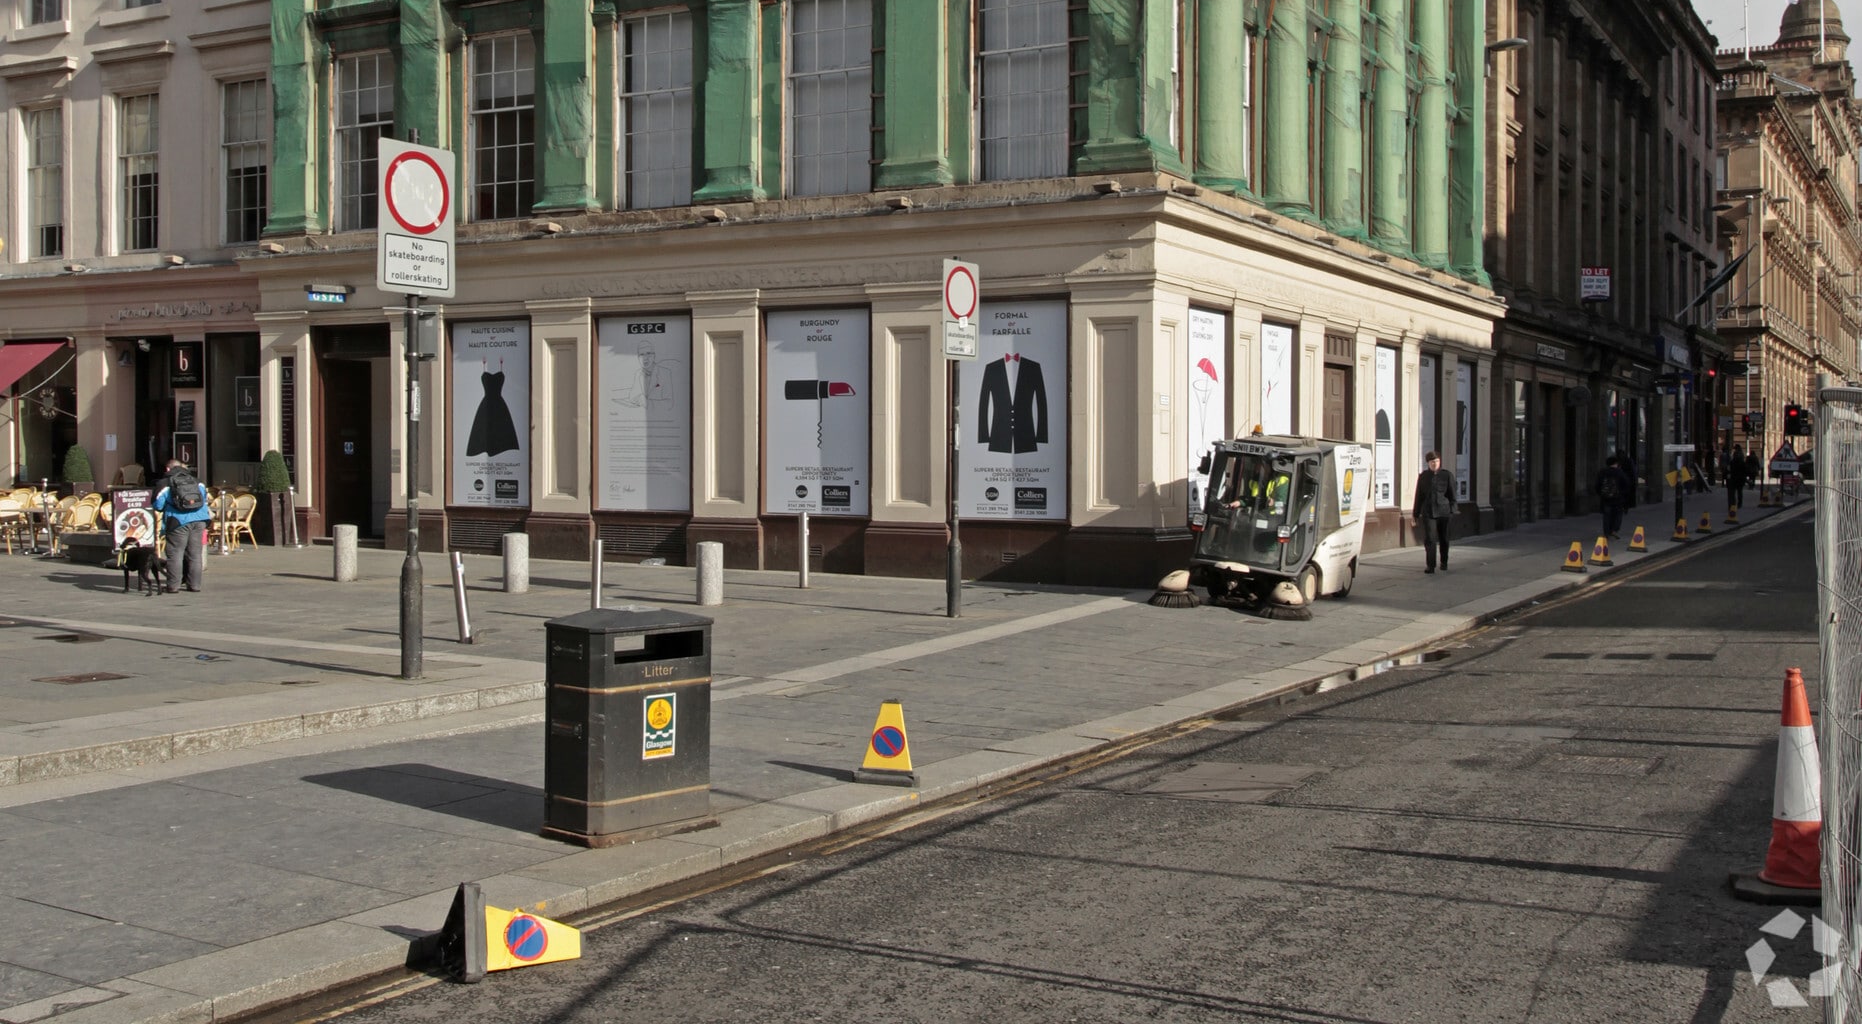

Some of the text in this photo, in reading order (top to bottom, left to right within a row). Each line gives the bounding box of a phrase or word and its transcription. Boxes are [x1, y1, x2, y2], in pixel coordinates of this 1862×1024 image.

[412, 242, 423, 251] No
[389, 250, 445, 265] skateboarding
[391, 272, 442, 285] rollerskating
[312, 293, 344, 303] GSPC
[630, 324, 663, 333] GSPC
[799, 319, 840, 327] BURGUNDY
[179, 349, 188, 371] b
[244, 388, 252, 407] b
[181, 445, 189, 463] b
[1349, 454, 1361, 465] Zero
[824, 488, 848, 496] Colliers
[1017, 490, 1044, 498] Colliers
[644, 665, 674, 677] Litter
